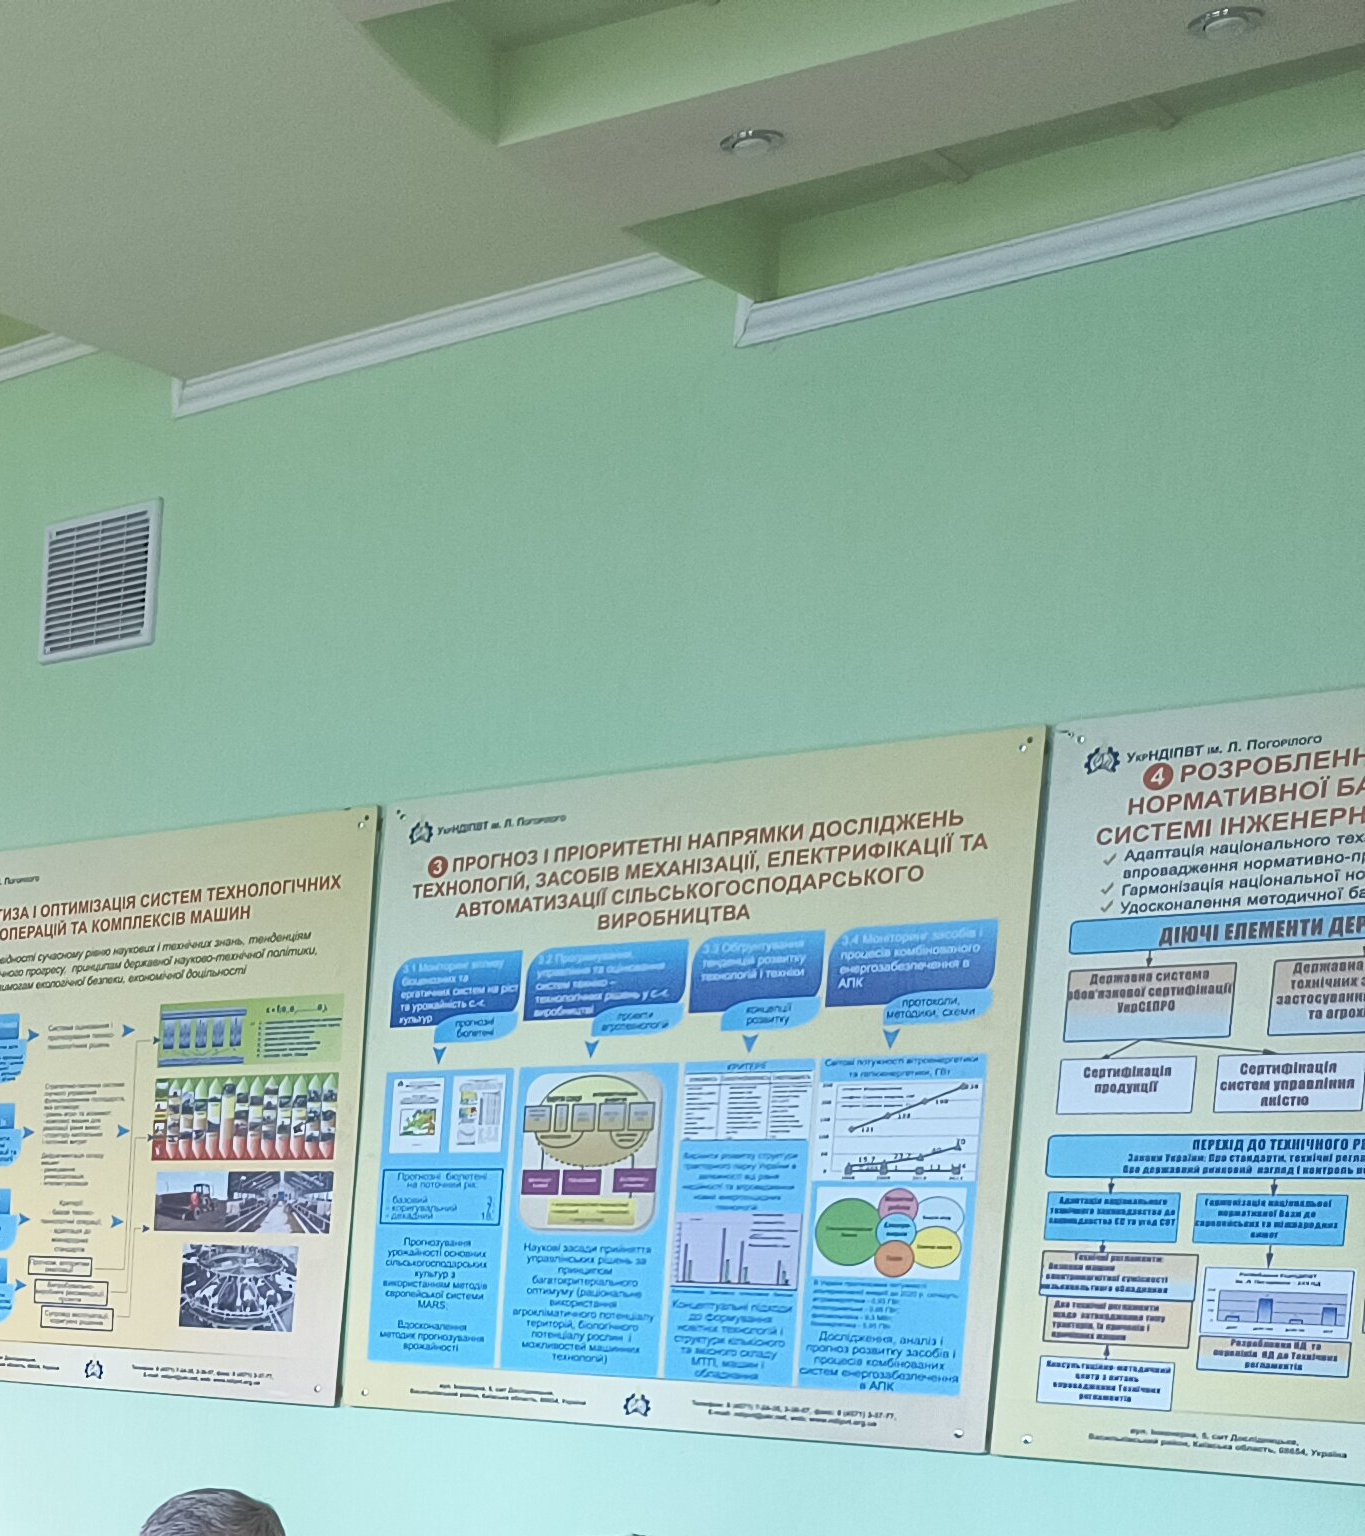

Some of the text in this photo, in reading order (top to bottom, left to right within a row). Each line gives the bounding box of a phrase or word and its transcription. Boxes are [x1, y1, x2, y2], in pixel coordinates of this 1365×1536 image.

[1227, 741, 1241, 752] Л.
[1151, 768, 1165, 785] 4
[1128, 776, 1328, 816] НОРМАТИВНОЇ
[433, 860, 443, 874] 3
[452, 852, 538, 873] ПРОГНОЗ
[554, 836, 681, 862] ПРІОРИТЕТНІ
[687, 823, 804, 851] НАПРЯМКИ
[809, 809, 963, 842] ДОСЛІДЖЕНЬ
[1096, 819, 1211, 845] СИСТЕМІ
[1125, 833, 1365, 862] Адаптація національного тех
[413, 833, 988, 899] ТЕХНОЛОГІЙ, ЗАСОБІВ МЕХАНІЗАЦІЇ, ЕЛЕКТРИФІКАЦІЇ ТА
[1123, 849, 1365, 880] впровадження нормативно-п
[41, 896, 136, 918] ОПТИМІЗАЦІЯ
[140, 889, 202, 908] СИСТЕМ
[207, 874, 341, 901] ТЕХНОЛОГІЧНИХ
[455, 865, 924, 919] АВТОМАТИЗАЦІЇ СІЛЬСЬКОГОСПОДАРСЬКОГО
[1121, 879, 1223, 897] Гармонізація
[1229, 868, 1340, 890] національної
[1121, 896, 1241, 915] Удосконалення
[1247, 887, 1342, 906] методичної
[0, 905, 250, 941] ОПЕРАЦІЙ ТА КОМПЛЕКСІВ МАШИН
[597, 904, 750, 931] ВИРОБНИЦТВА
[1159, 923, 1219, 946] ДІЮЧІ
[1224, 918, 1323, 940] ЕЛЕМЕНТИ
[838, 978, 864, 988] АПК
[1247, 1139, 1265, 1152] ДО
[869, 1382, 894, 1391] АПК
